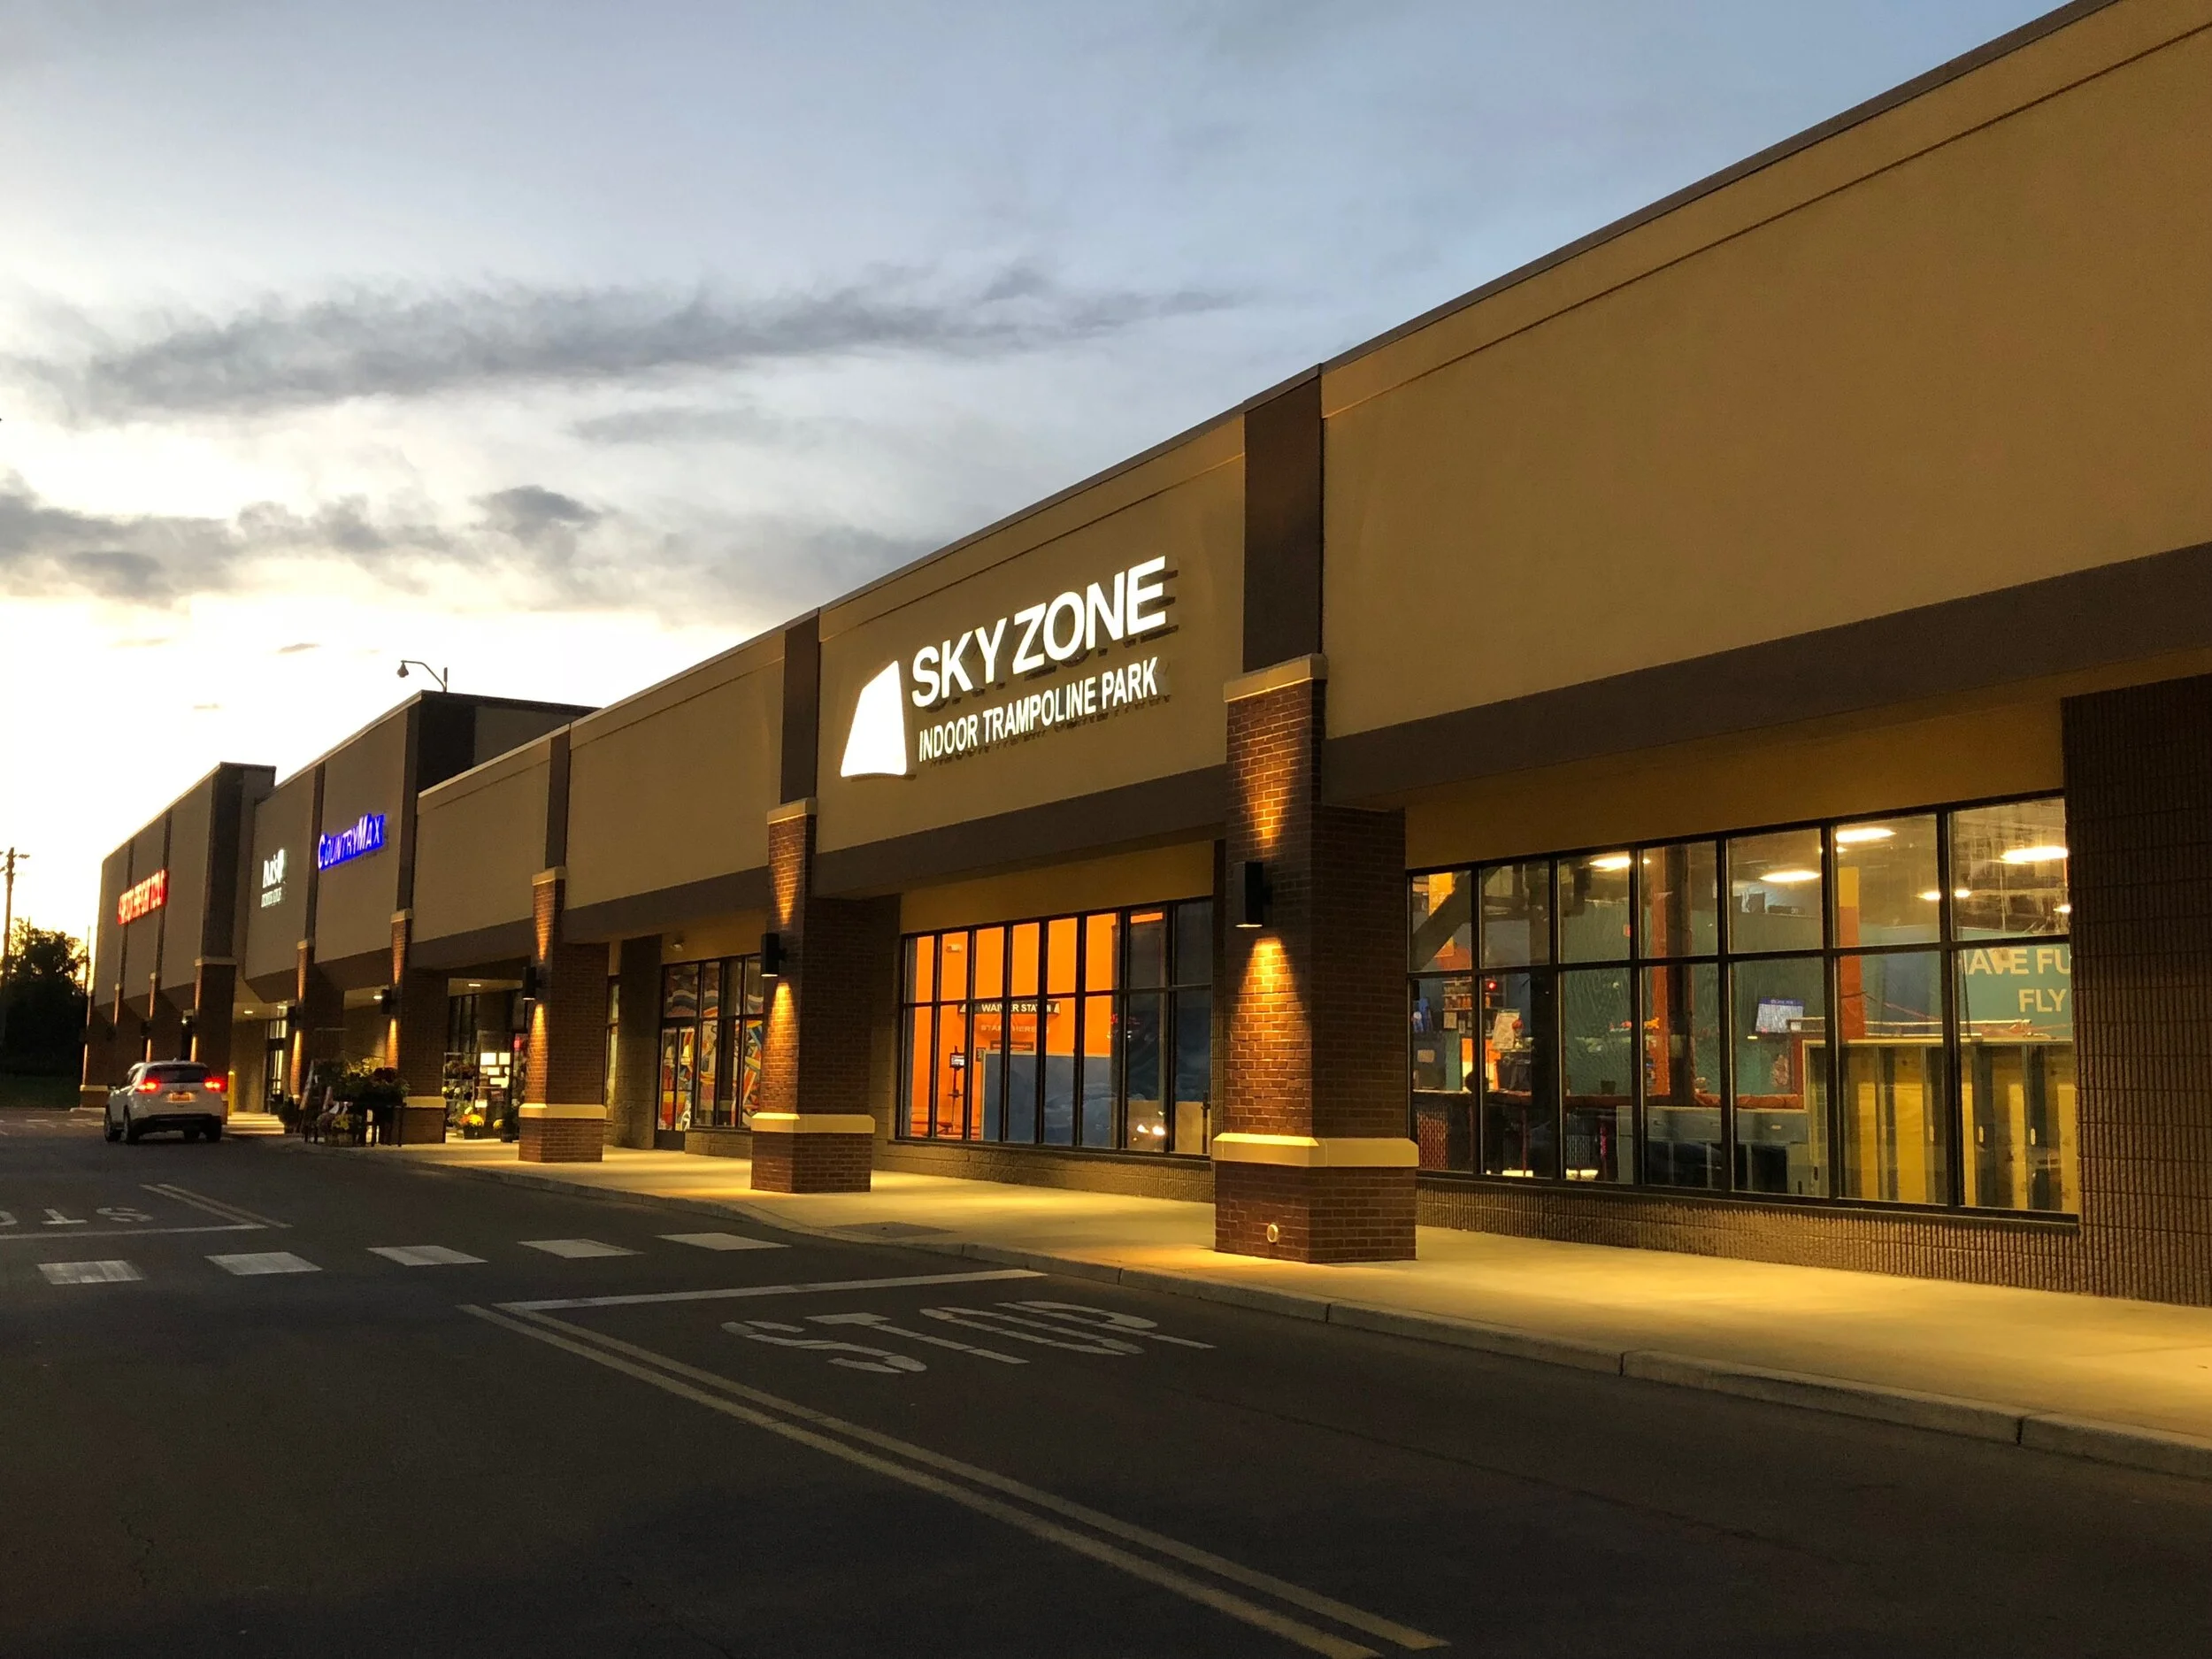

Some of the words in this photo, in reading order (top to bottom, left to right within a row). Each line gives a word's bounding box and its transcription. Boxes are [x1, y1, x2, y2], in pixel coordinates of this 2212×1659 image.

[911, 618, 1007, 708] SKY
[1012, 556, 1166, 674] ZONE
[918, 712, 979, 762] INDOOR
[983, 676, 1096, 740] TRAMPOLINE
[1101, 657, 1158, 710] PARK
[1962, 949, 2030, 975] AVE
[981, 1003, 1019, 1012] WAIR
[1021, 1003, 1052, 1012] STAN
[2018, 988, 2067, 1012] FLY
[720, 1300, 1217, 1373] STOP
